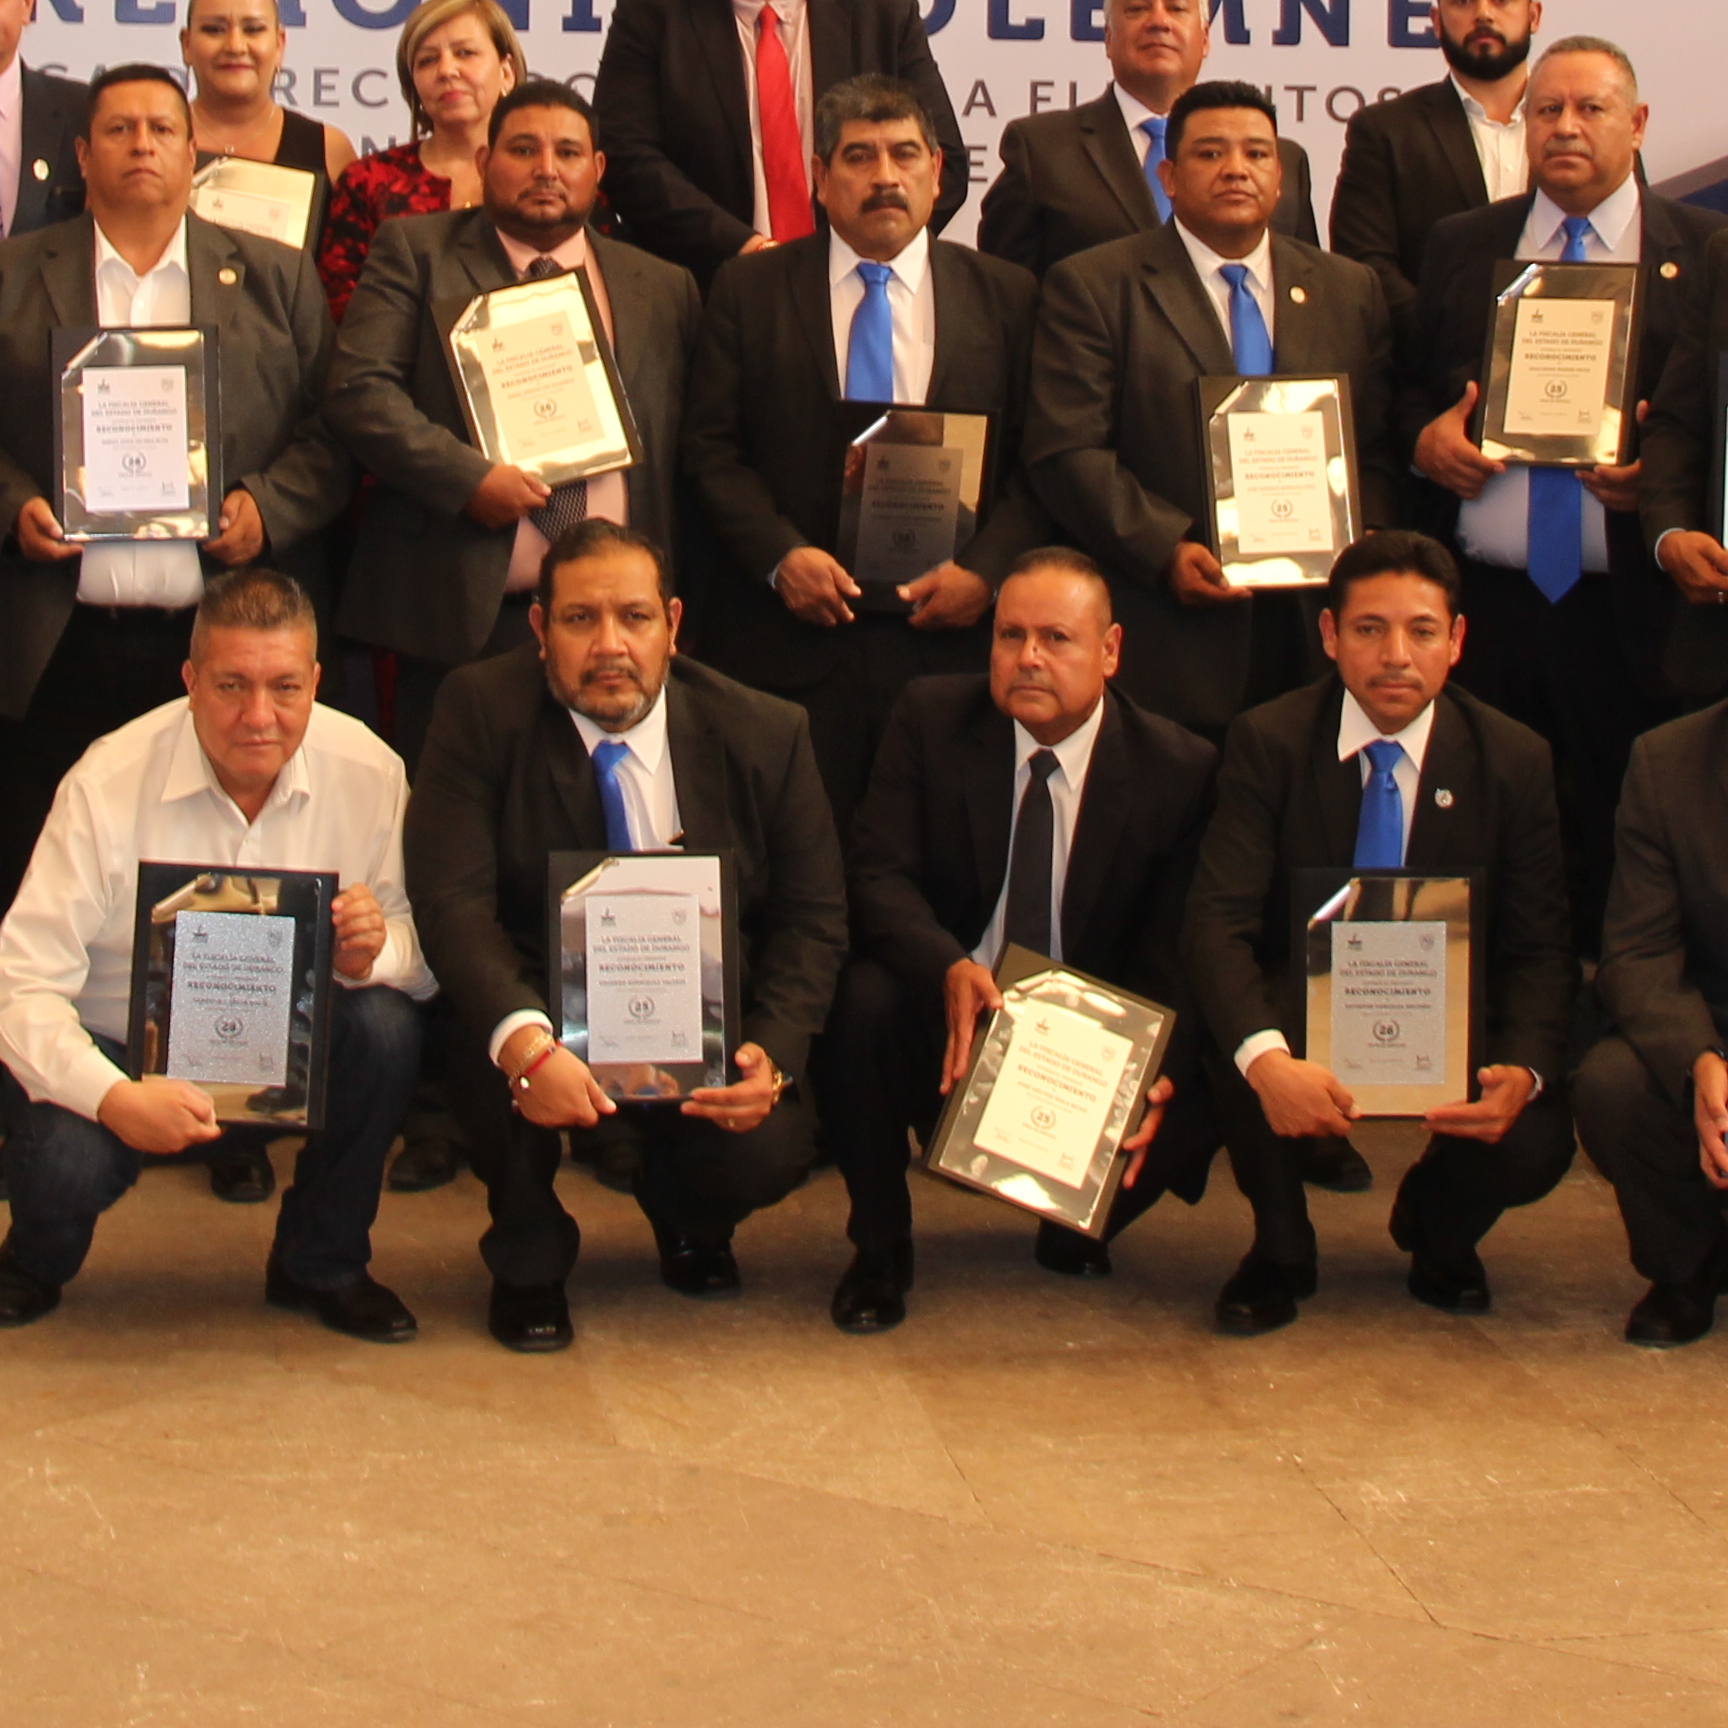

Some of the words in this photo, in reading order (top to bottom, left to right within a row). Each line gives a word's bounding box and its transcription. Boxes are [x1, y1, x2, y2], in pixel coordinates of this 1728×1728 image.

[1525, 353, 1596, 361] RECONOCIMIENTO
[1245, 471, 1314, 480] RECONOCIMIENTO
[599, 963, 684, 972] RECONOCIMIENTO
[187, 981, 276, 993] RECONOCIMIENTO
[1345, 987, 1431, 995] RECONOCIMIENTO
[1019, 1064, 1096, 1102] RECONOCIMIENTO
[1036, 1112, 1051, 1124] 25
